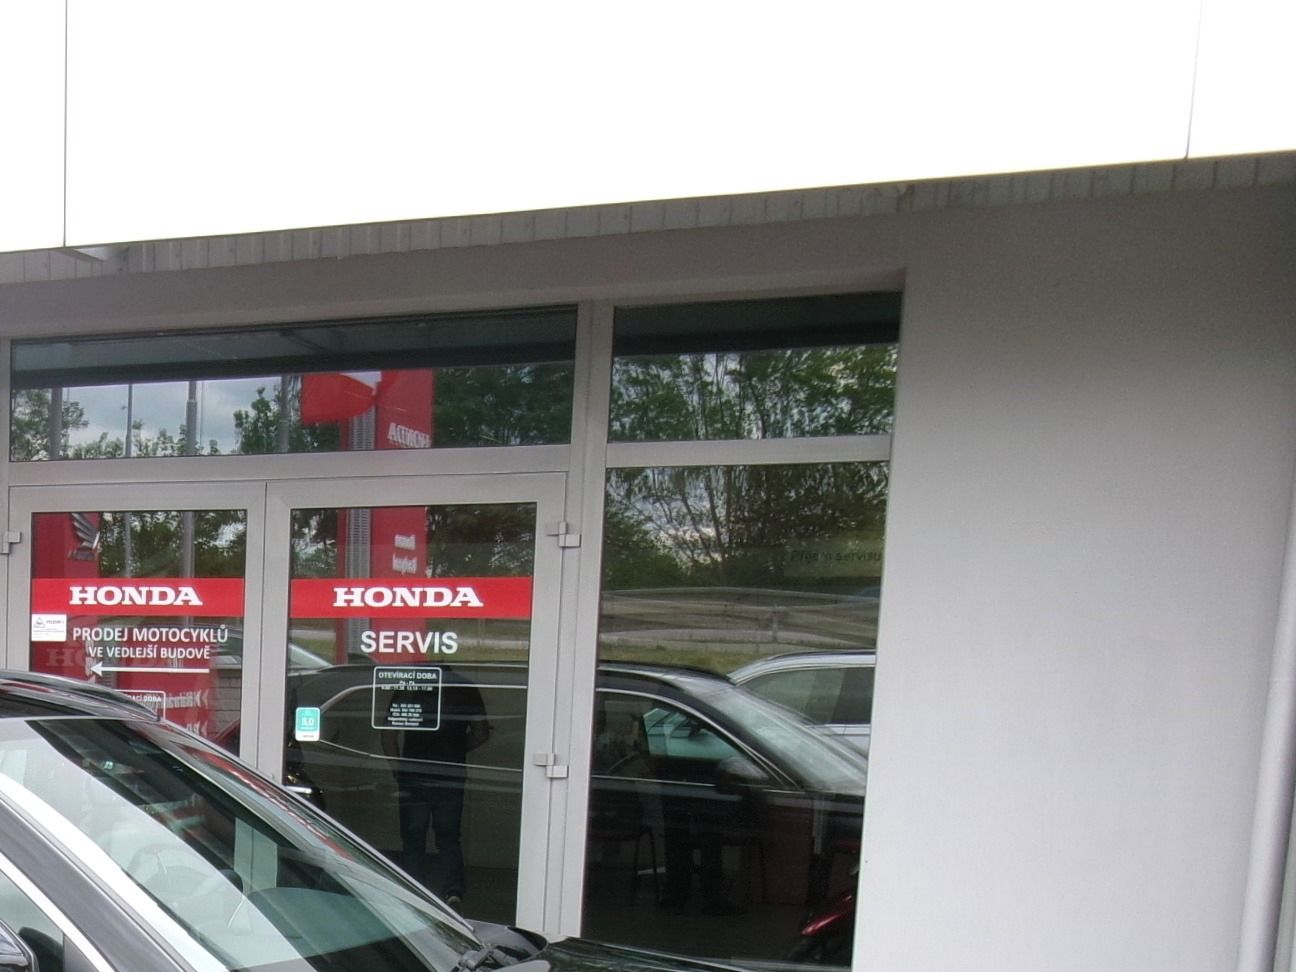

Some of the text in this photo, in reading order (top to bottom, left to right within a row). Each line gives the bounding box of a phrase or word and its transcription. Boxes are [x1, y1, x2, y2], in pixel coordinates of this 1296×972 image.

[69, 585, 203, 606] HONDA
[332, 586, 484, 607] HONDA
[72, 624, 229, 643] PRODEJ MOTOCYKLŮ
[360, 630, 458, 654] SERVIS
[88, 646, 104, 658] VE
[106, 644, 158, 659] VEDLEJŠÍ
[160, 645, 211, 660] BUDOVĚ
[378, 671, 437, 680] OTEVÍRACÍ DOBA
